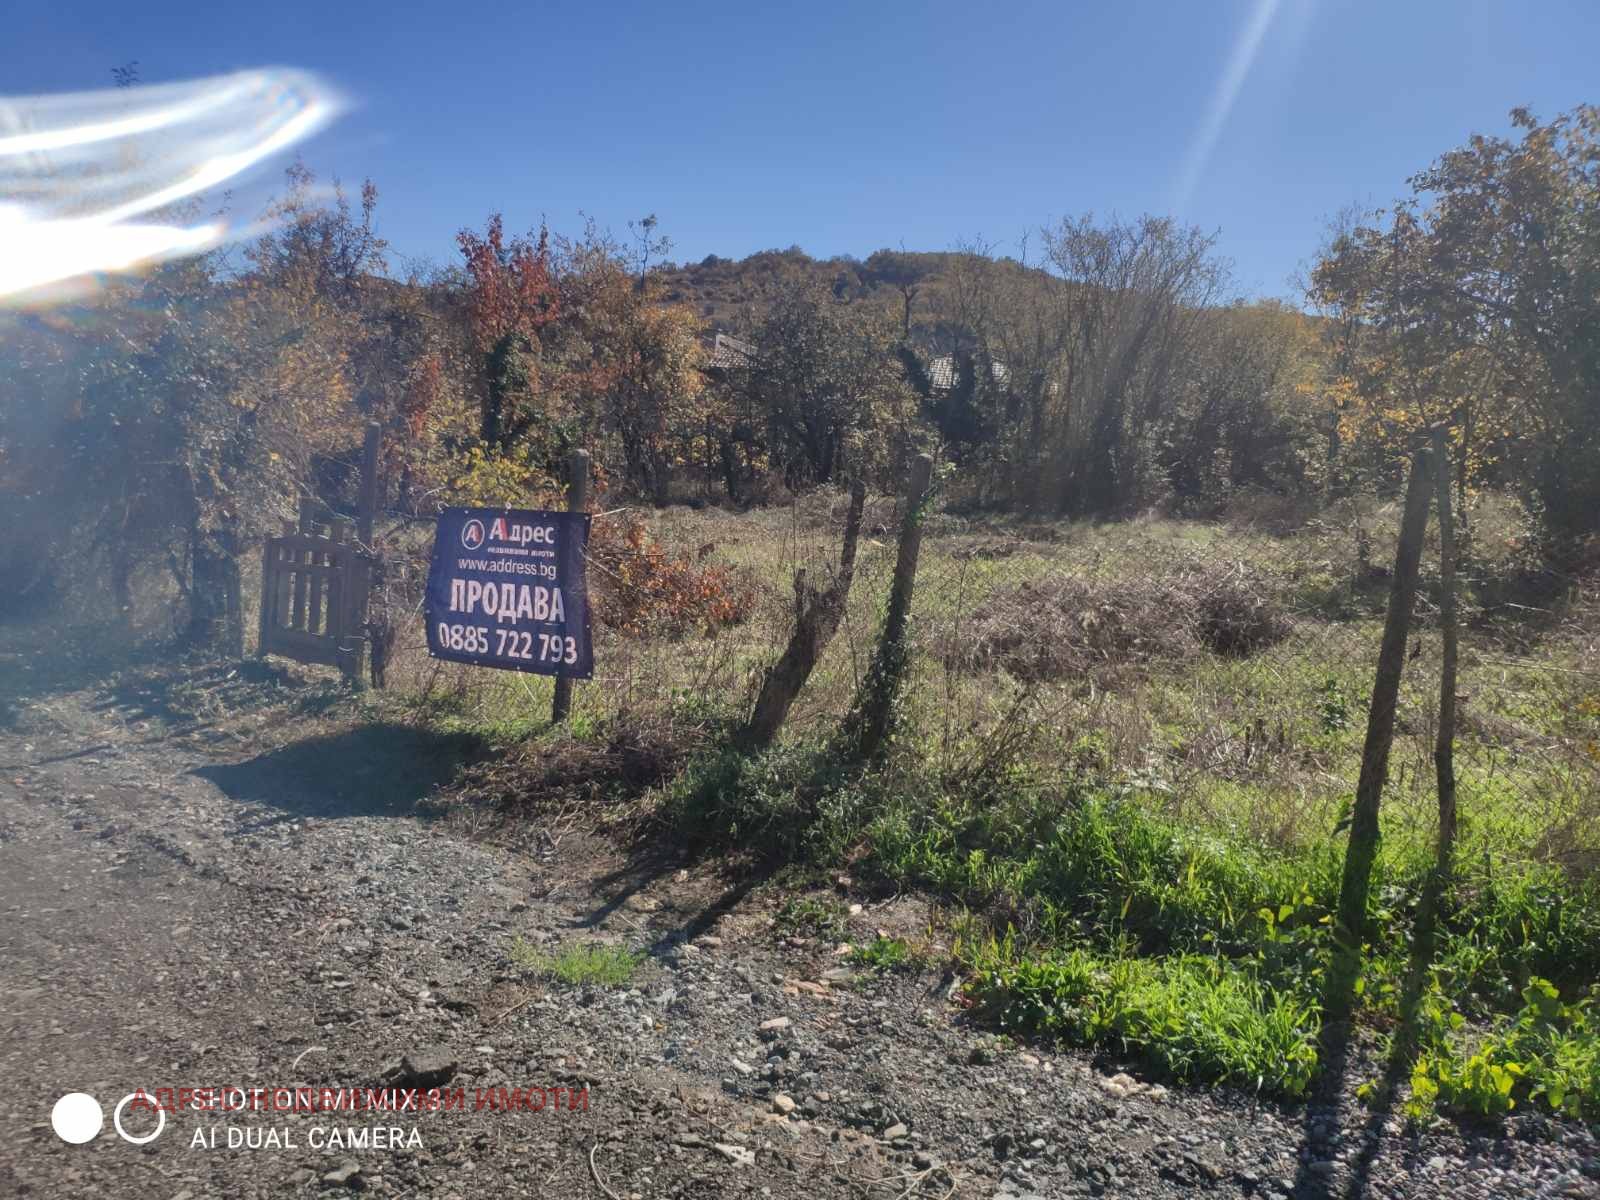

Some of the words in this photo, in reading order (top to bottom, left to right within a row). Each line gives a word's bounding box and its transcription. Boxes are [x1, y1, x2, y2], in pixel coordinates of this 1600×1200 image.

[489, 518, 555, 546] Адрес
[458, 558, 557, 580] www.address.bg
[449, 578, 566, 625] ПРОДАВА
[438, 622, 489, 654] 0885
[496, 629, 533, 660] 722
[538, 634, 578, 665] 793
